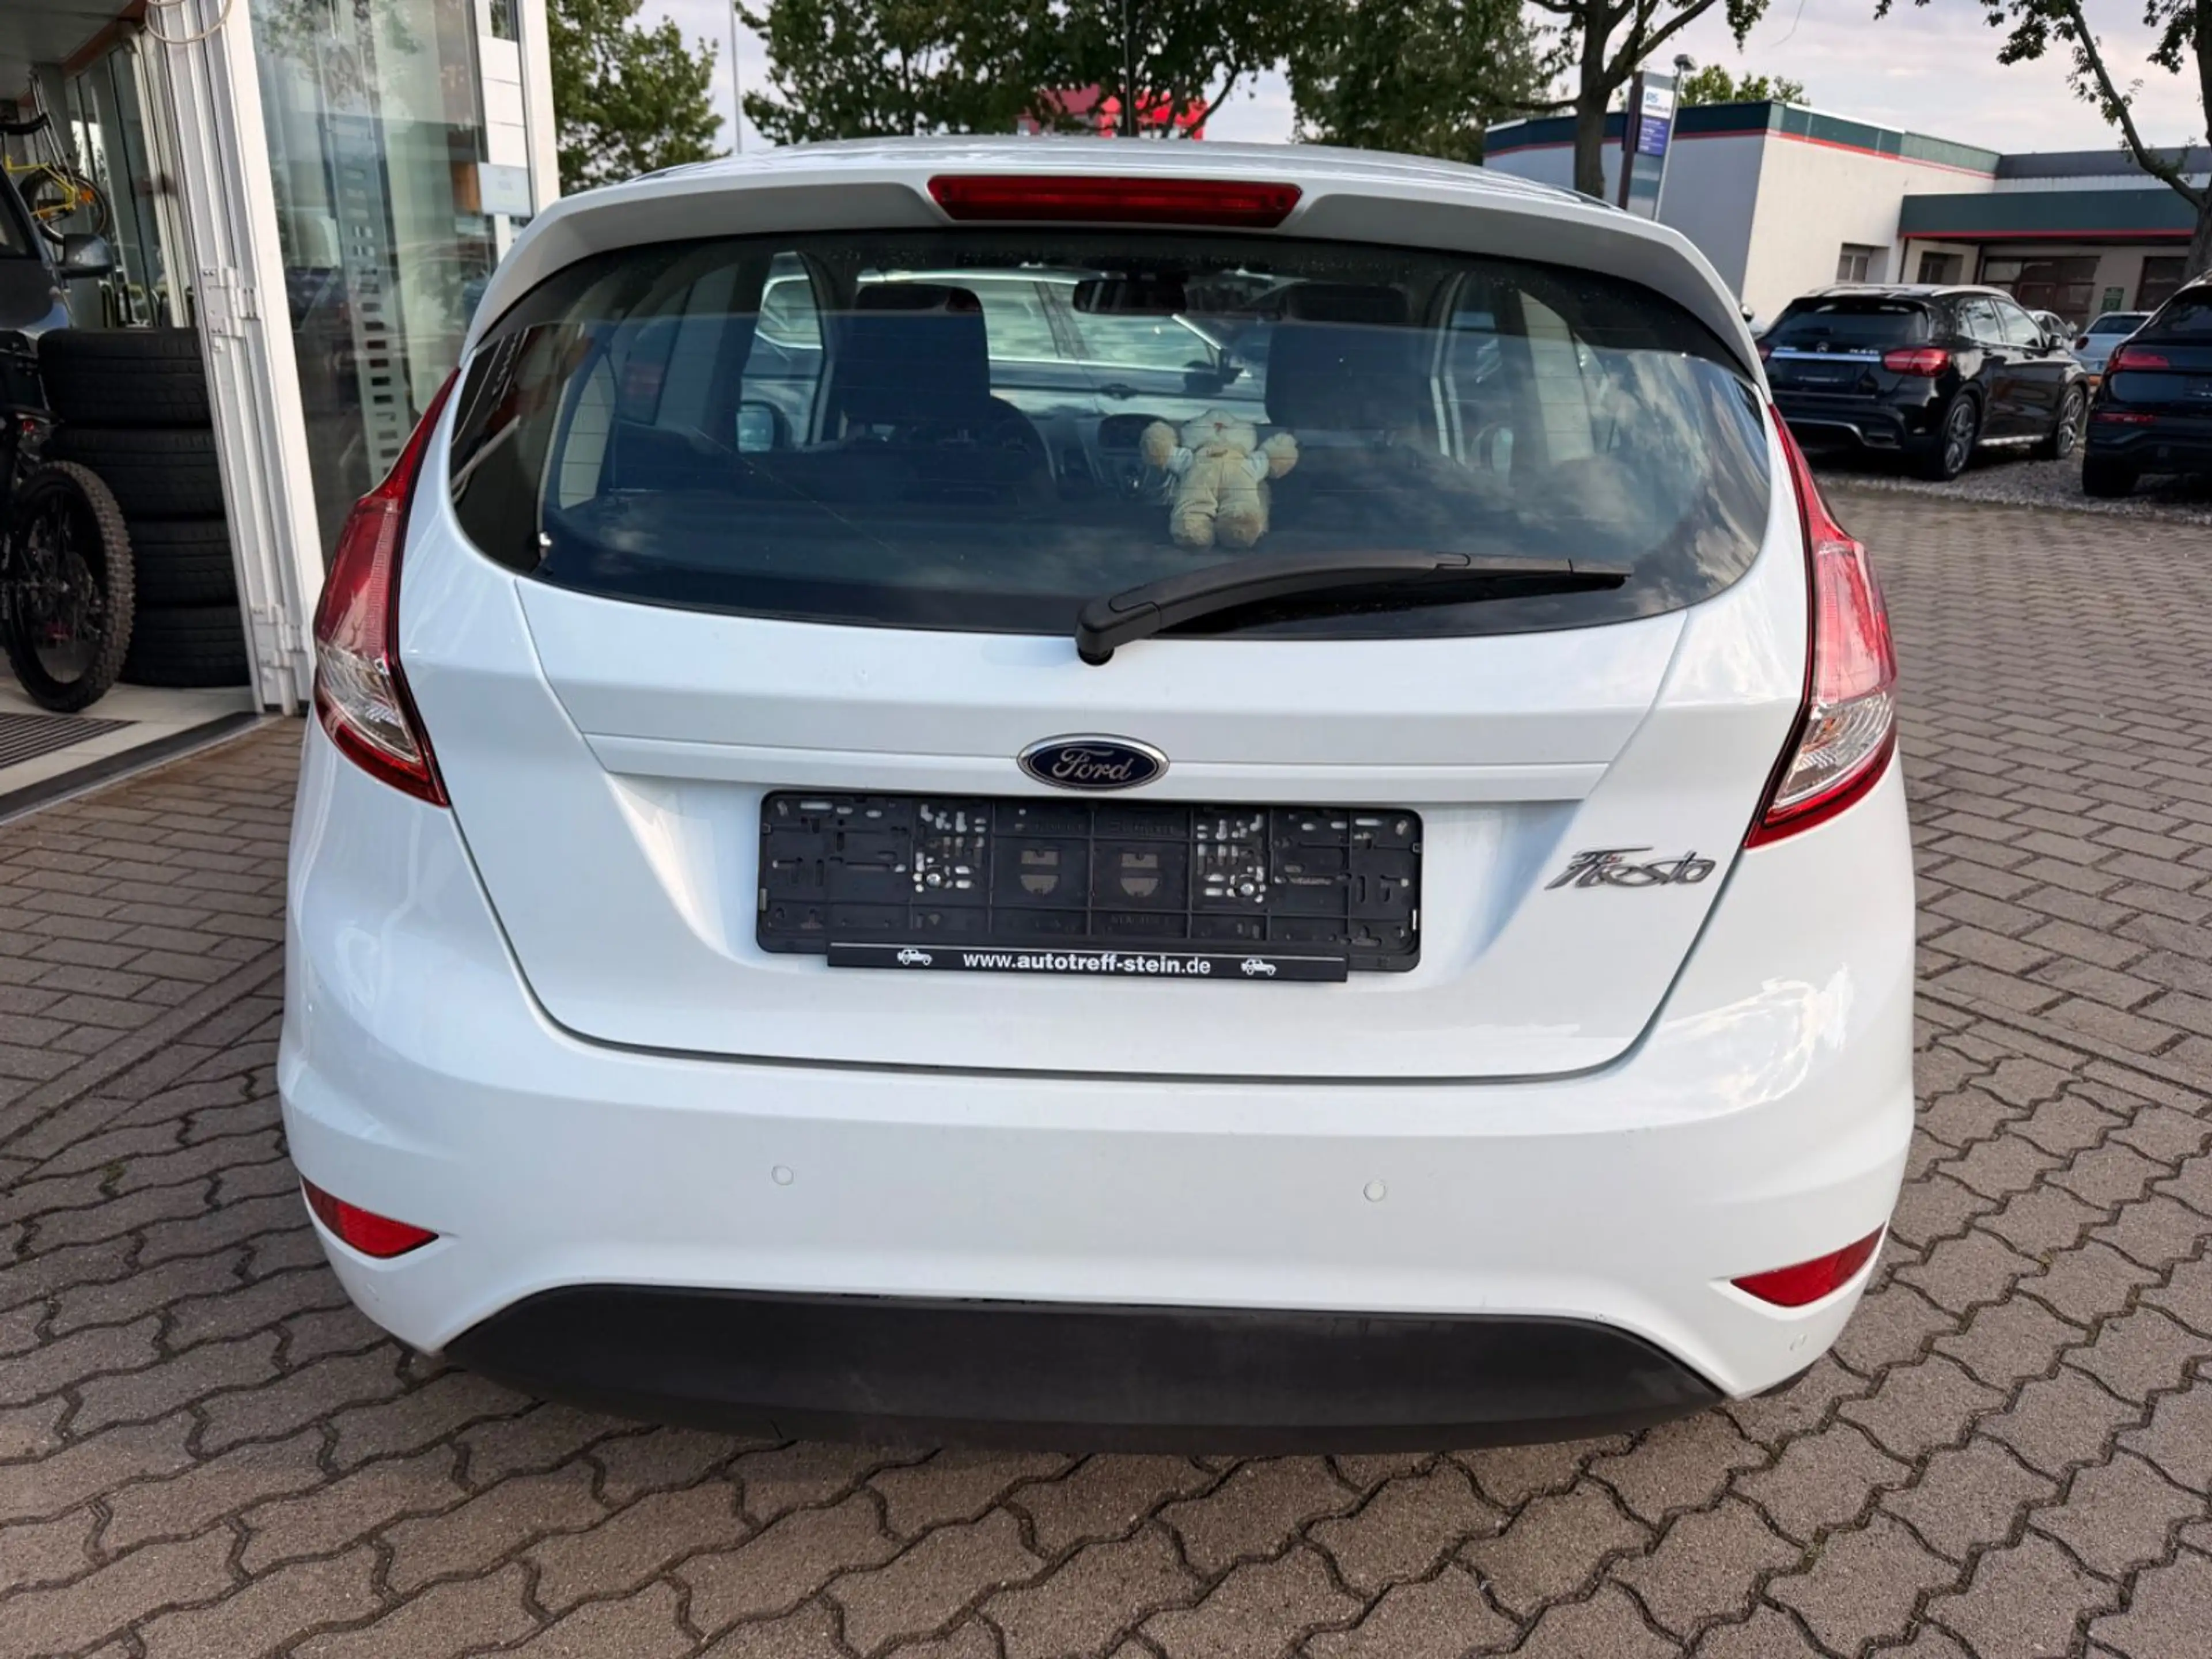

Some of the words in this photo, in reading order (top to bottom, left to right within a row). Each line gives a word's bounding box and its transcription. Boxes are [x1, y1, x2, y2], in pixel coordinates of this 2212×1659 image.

[1051, 748, 1134, 781] Ford
[1543, 846, 1717, 891] Fiesta
[963, 952, 1211, 975] www.autotreff-stein.de
